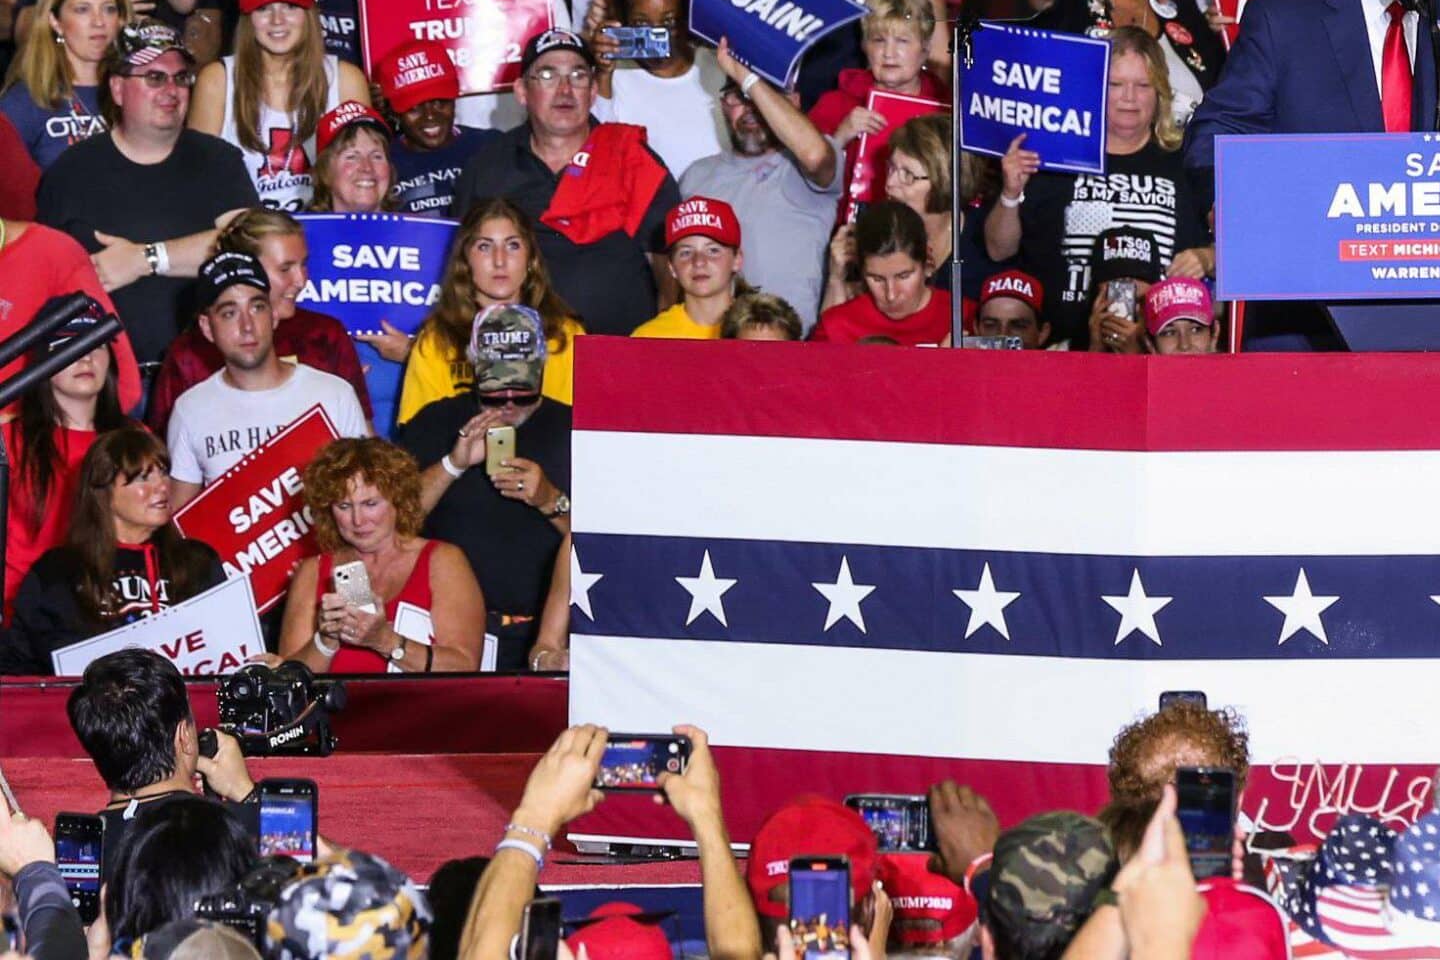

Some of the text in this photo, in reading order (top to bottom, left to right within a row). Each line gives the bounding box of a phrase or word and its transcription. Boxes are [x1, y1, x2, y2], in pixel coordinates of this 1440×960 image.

[409, 17, 471, 41] TRU
[397, 50, 428, 73] SAVE
[393, 62, 445, 89] AMERICA
[992, 59, 1062, 94] SAVE
[335, 103, 367, 116] SAVE
[969, 91, 1092, 136] AMERICA!
[428, 166, 462, 182] NAT
[1074, 172, 1176, 196] JESUS
[411, 194, 453, 211] UNDE
[678, 200, 709, 216] SAVE
[1074, 188, 1089, 199] IS
[1119, 190, 1177, 208] SAVIOR
[671, 214, 723, 232] AMERICA
[1356, 222, 1426, 234] PRESIDENT
[1104, 238, 1135, 251] LT'S
[1104, 248, 1152, 262] BRANDON
[1349, 244, 1388, 257] TEXT
[333, 245, 420, 271] SAVE
[298, 278, 441, 307] AMERICA
[988, 277, 1033, 297] MAGA
[483, 331, 530, 345] TRUMP
[205, 424, 286, 458] BAR HAR
[230, 467, 306, 534] SAVE
[221, 505, 317, 580] AMERIC
[160, 629, 208, 660] VE
[269, 725, 305, 748] RONIN
